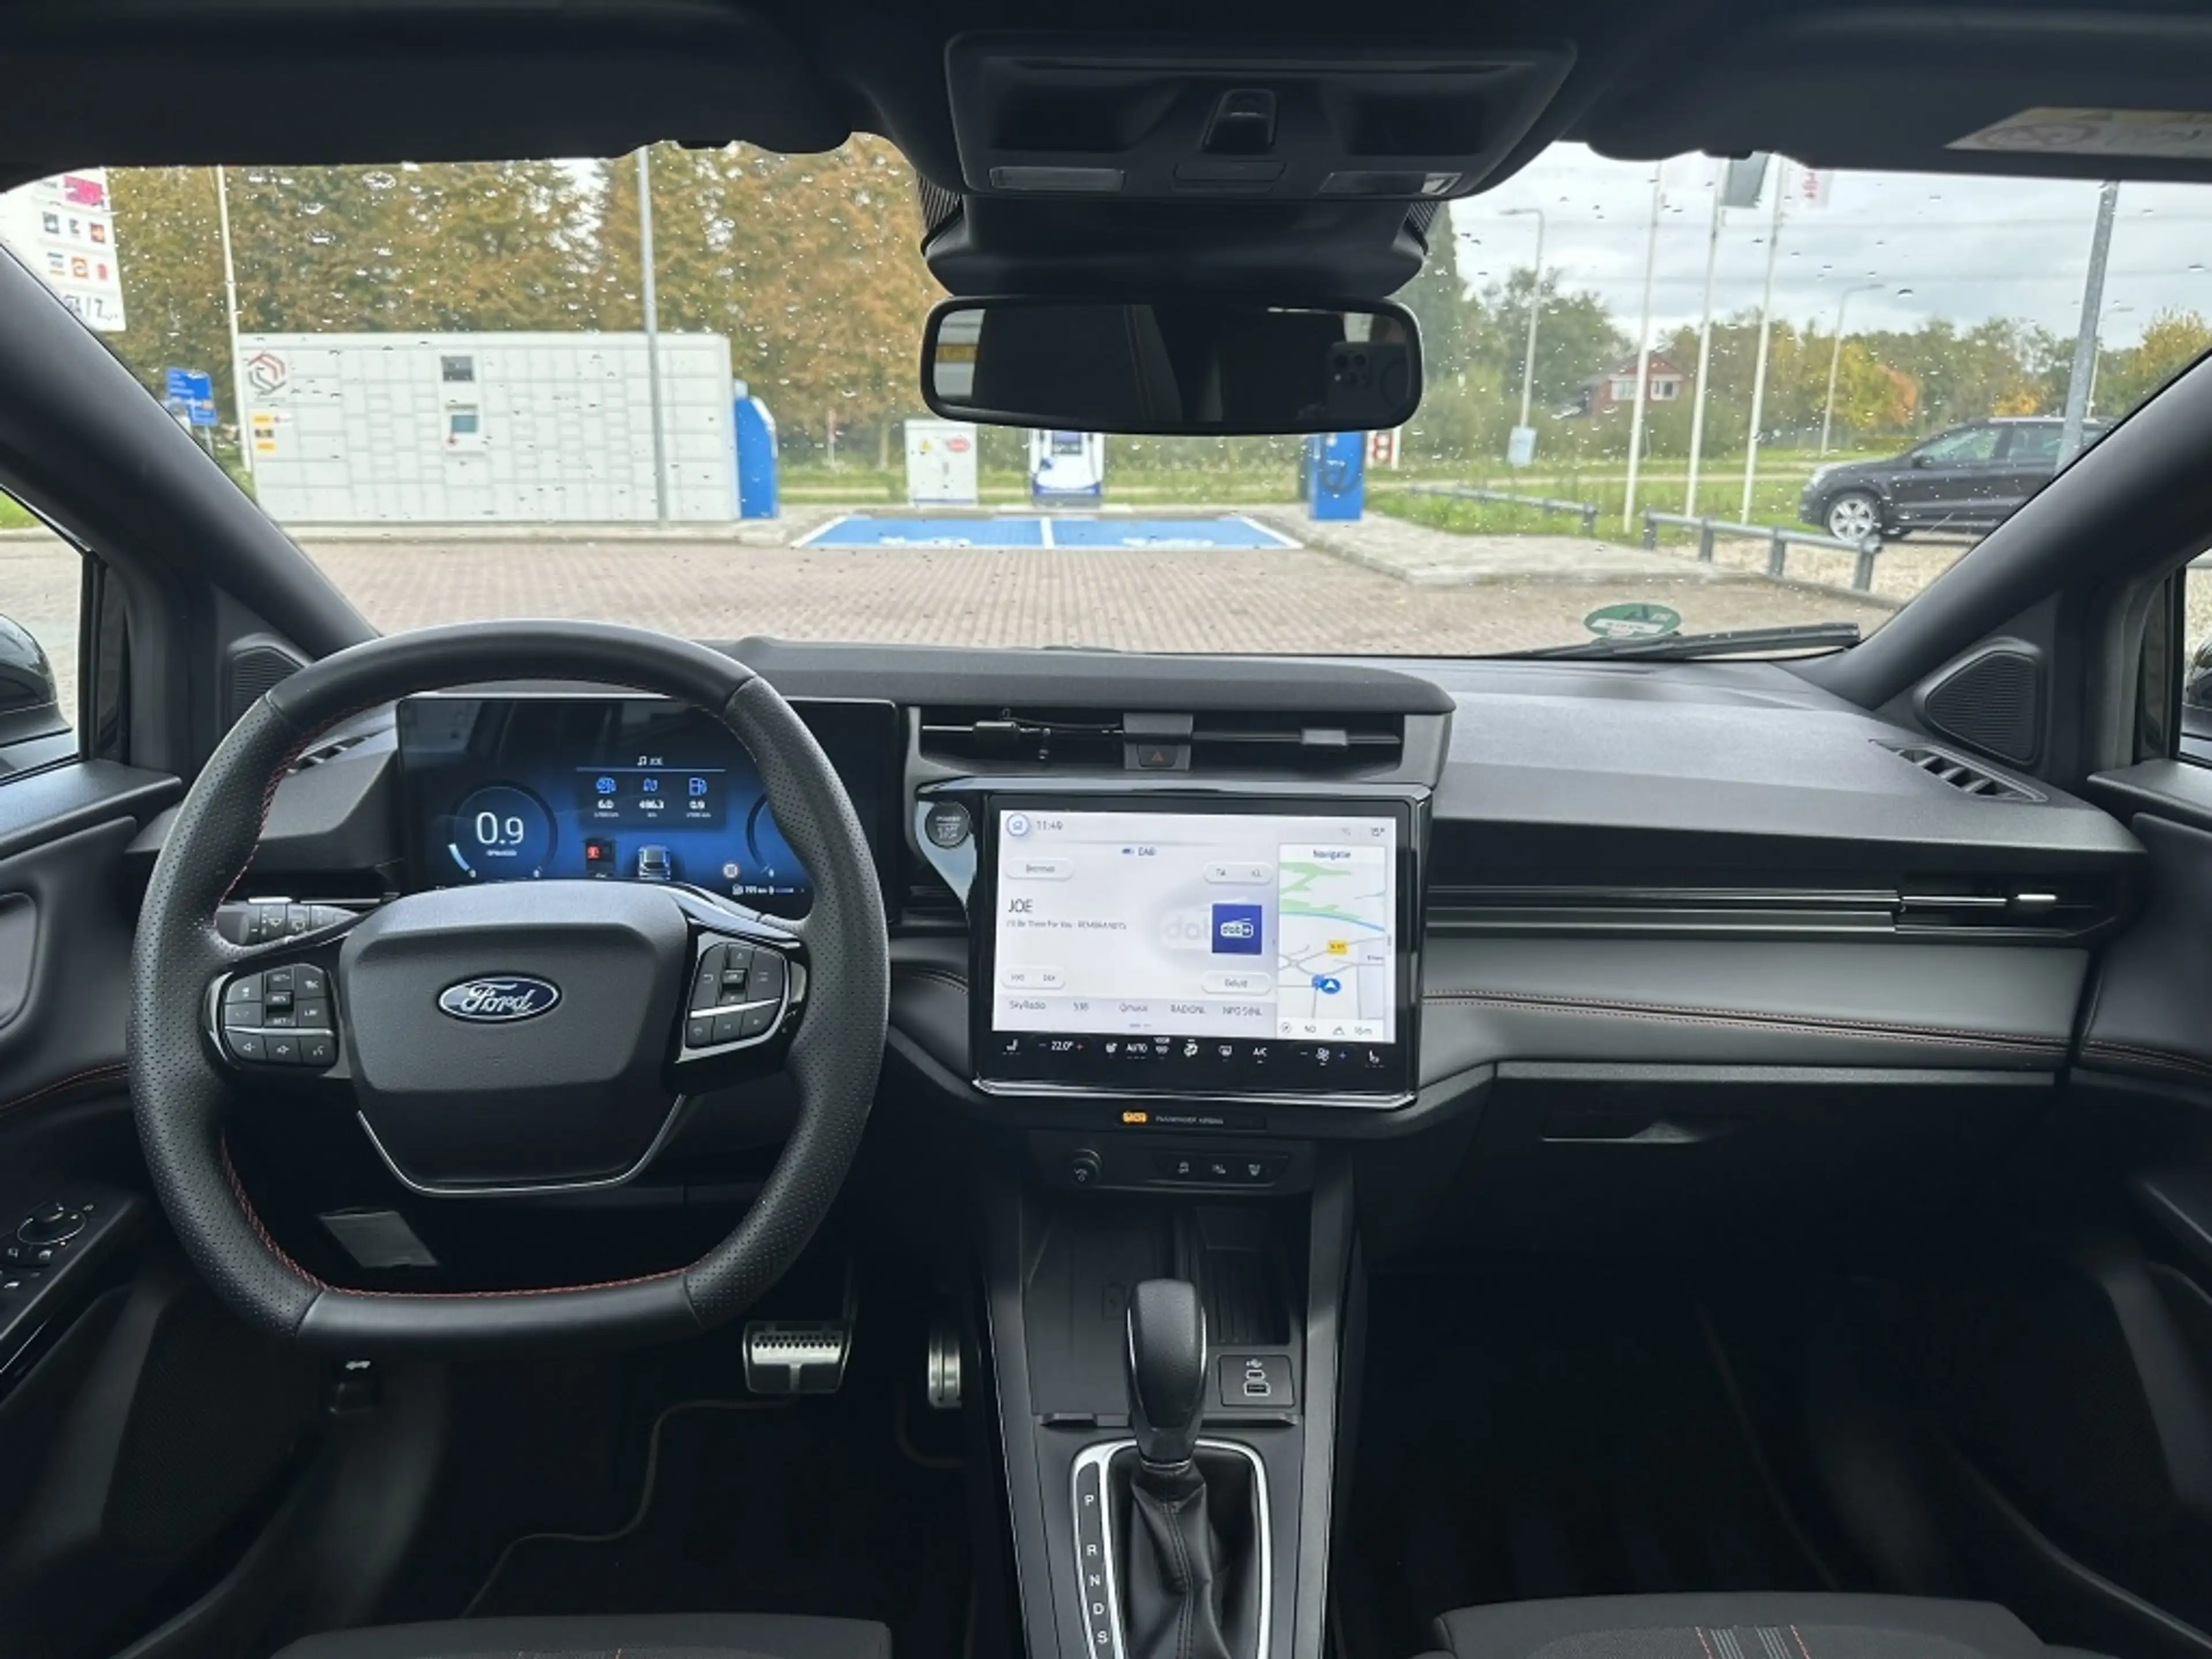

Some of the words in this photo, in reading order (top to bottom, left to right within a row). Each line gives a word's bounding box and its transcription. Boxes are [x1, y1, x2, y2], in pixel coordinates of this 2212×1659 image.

[476, 812, 524, 844] 0.9
[1313, 849, 1351, 861] Navigatie
[1008, 899, 1033, 913] JOE
[460, 983, 537, 1012] Ford
[1126, 1043, 1147, 1053] AUTO
[1252, 1047, 1267, 1056] A/C
[1084, 1495, 1094, 1506] P
[1086, 1544, 1097, 1556] R
[1089, 1575, 1101, 1586] N
[1093, 1603, 1104, 1614] D
